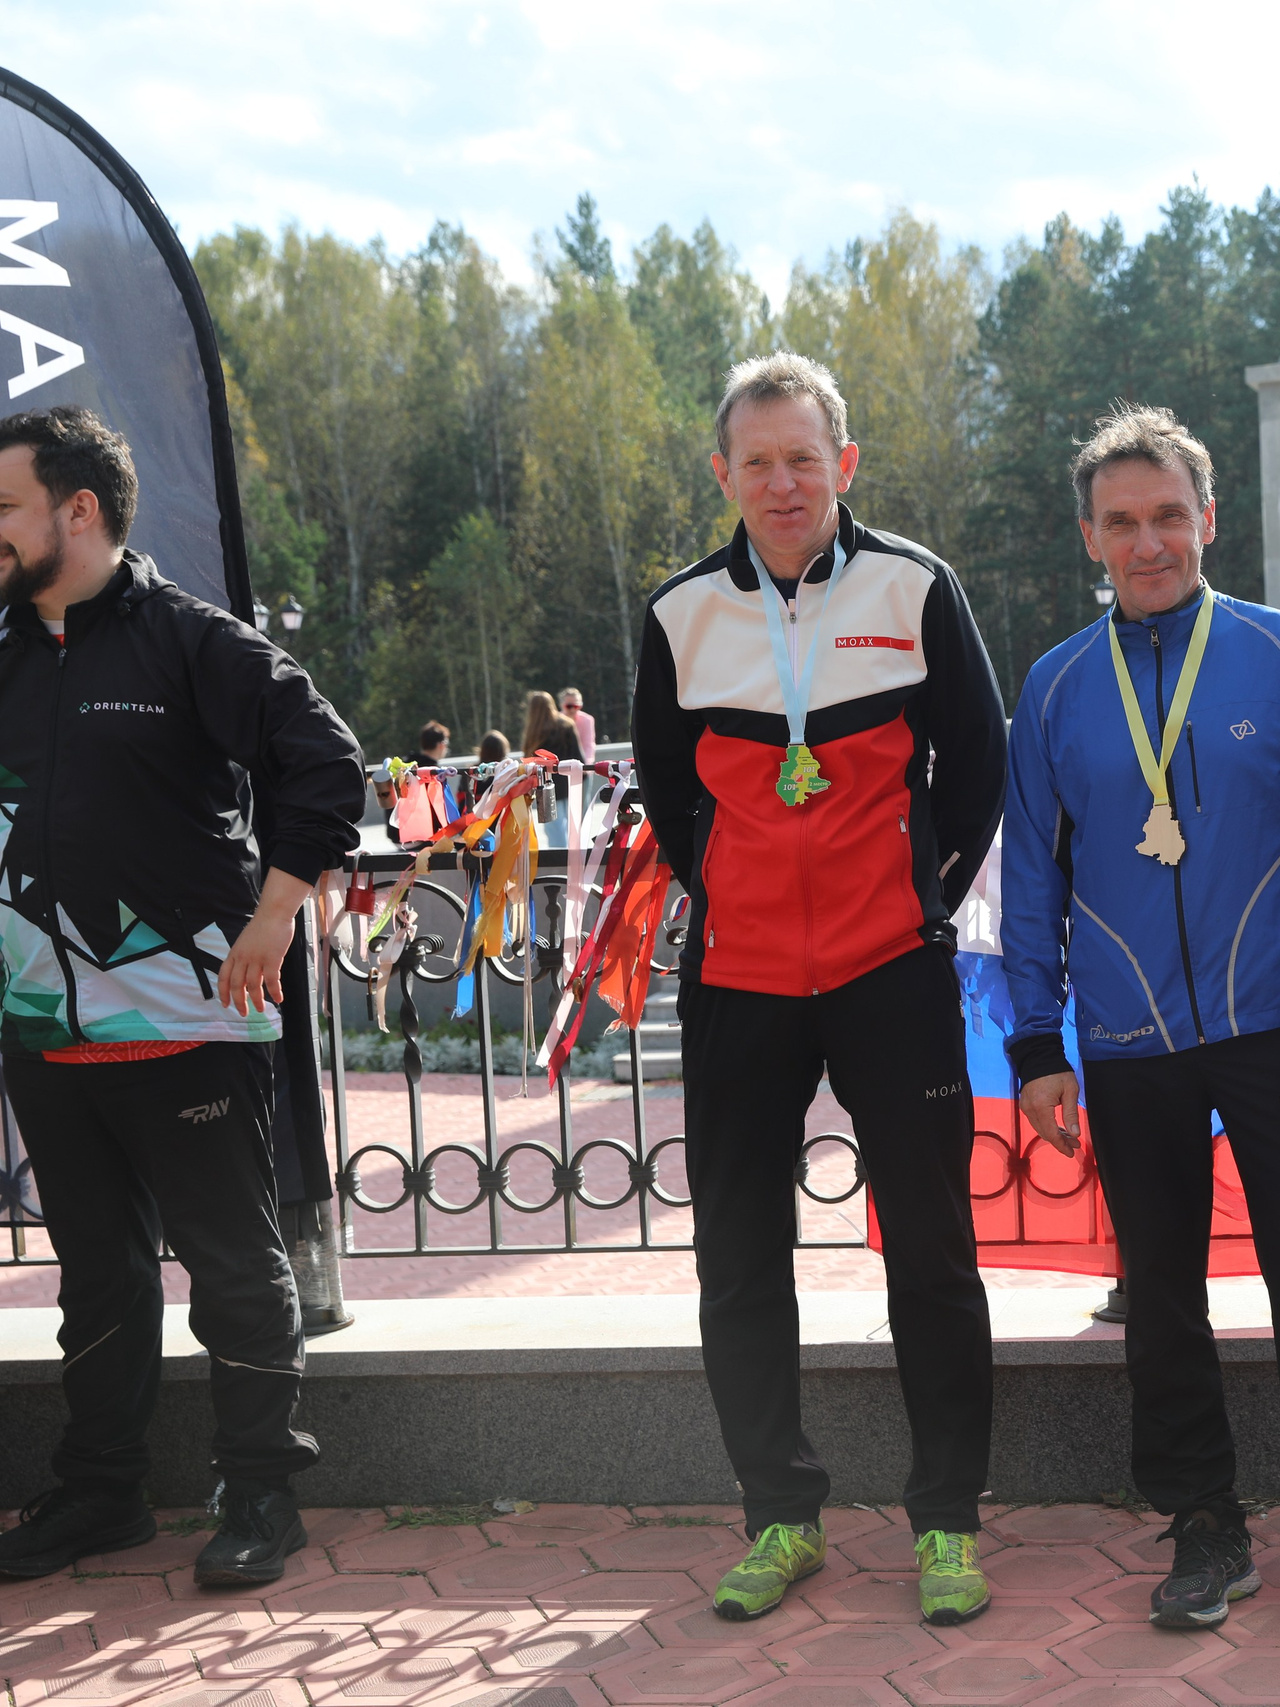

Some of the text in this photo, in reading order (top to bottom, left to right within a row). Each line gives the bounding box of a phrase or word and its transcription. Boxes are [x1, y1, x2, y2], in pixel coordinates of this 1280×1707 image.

[837, 637, 874, 647] MOAX
[93, 701, 165, 715] ORIENTEAM
[1105, 1025, 1155, 1043] NORD
[925, 1081, 963, 1100] MOAX
[191, 1097, 231, 1125] RAY
